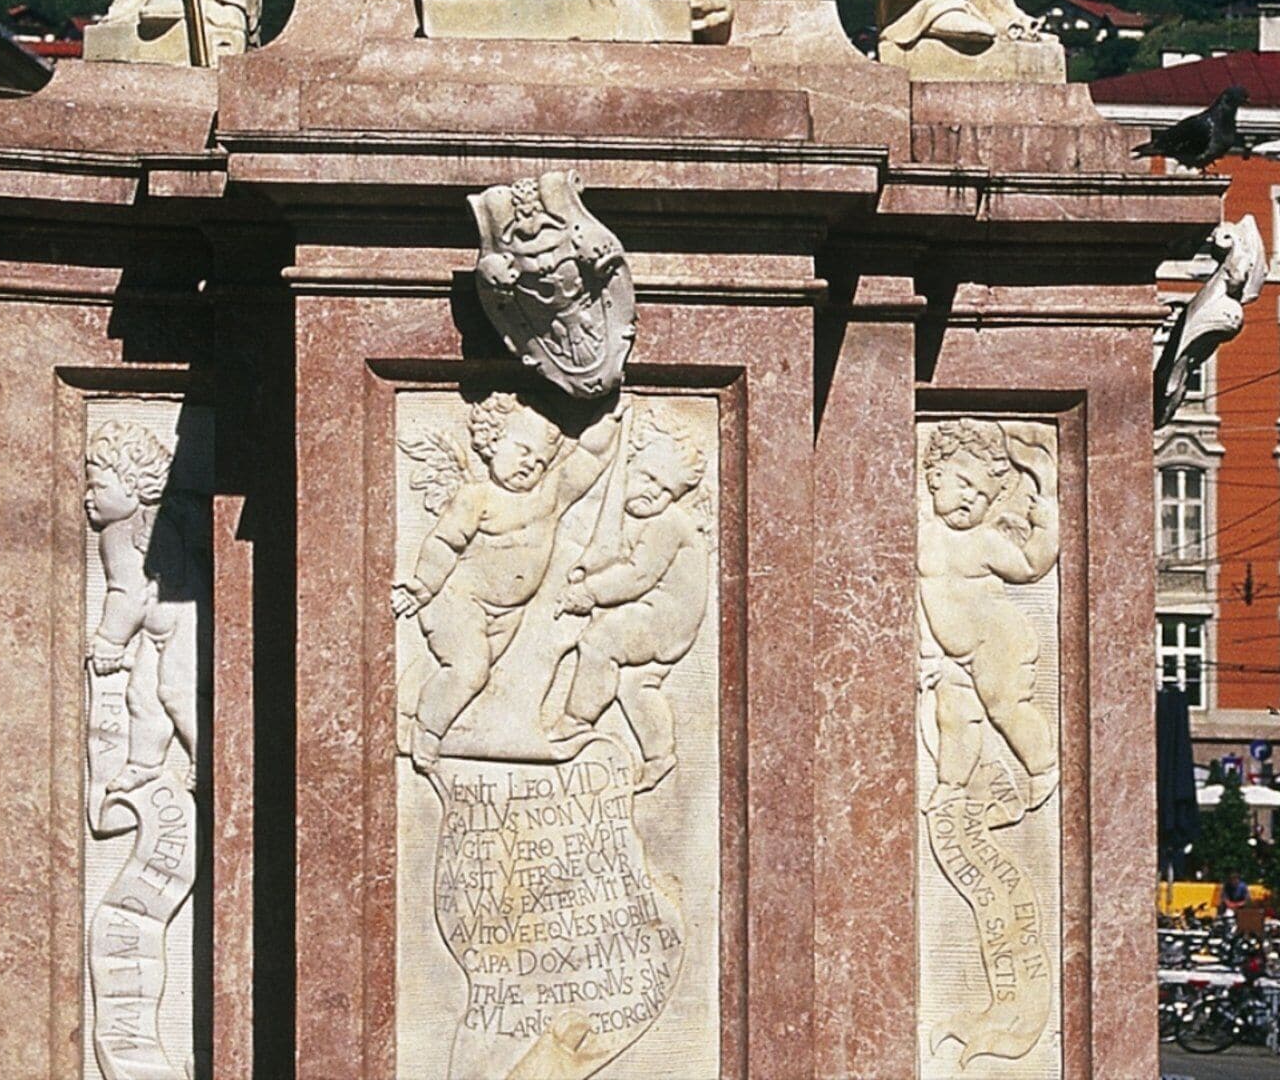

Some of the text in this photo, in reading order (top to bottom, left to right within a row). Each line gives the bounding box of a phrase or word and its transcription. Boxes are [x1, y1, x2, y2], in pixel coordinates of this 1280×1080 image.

[99, 691, 122, 754] IPSA
[555, 757, 630, 796] VIDIT
[446, 802, 520, 834] GALLVS
[525, 802, 574, 829] NON
[439, 820, 629, 860] FVGIT VERO ERVPIT
[498, 856, 583, 888] VTERQVE
[586, 849, 630, 874] CVR
[464, 887, 514, 916] VNVS
[962, 801, 1047, 980] DAMENTA EIVS IN
[585, 928, 651, 970] HVIVS
[658, 927, 682, 951] PA
[537, 967, 633, 1004] PATRONVS
[640, 958, 670, 990] SIN
[589, 983, 667, 1035] GEORGIVS
